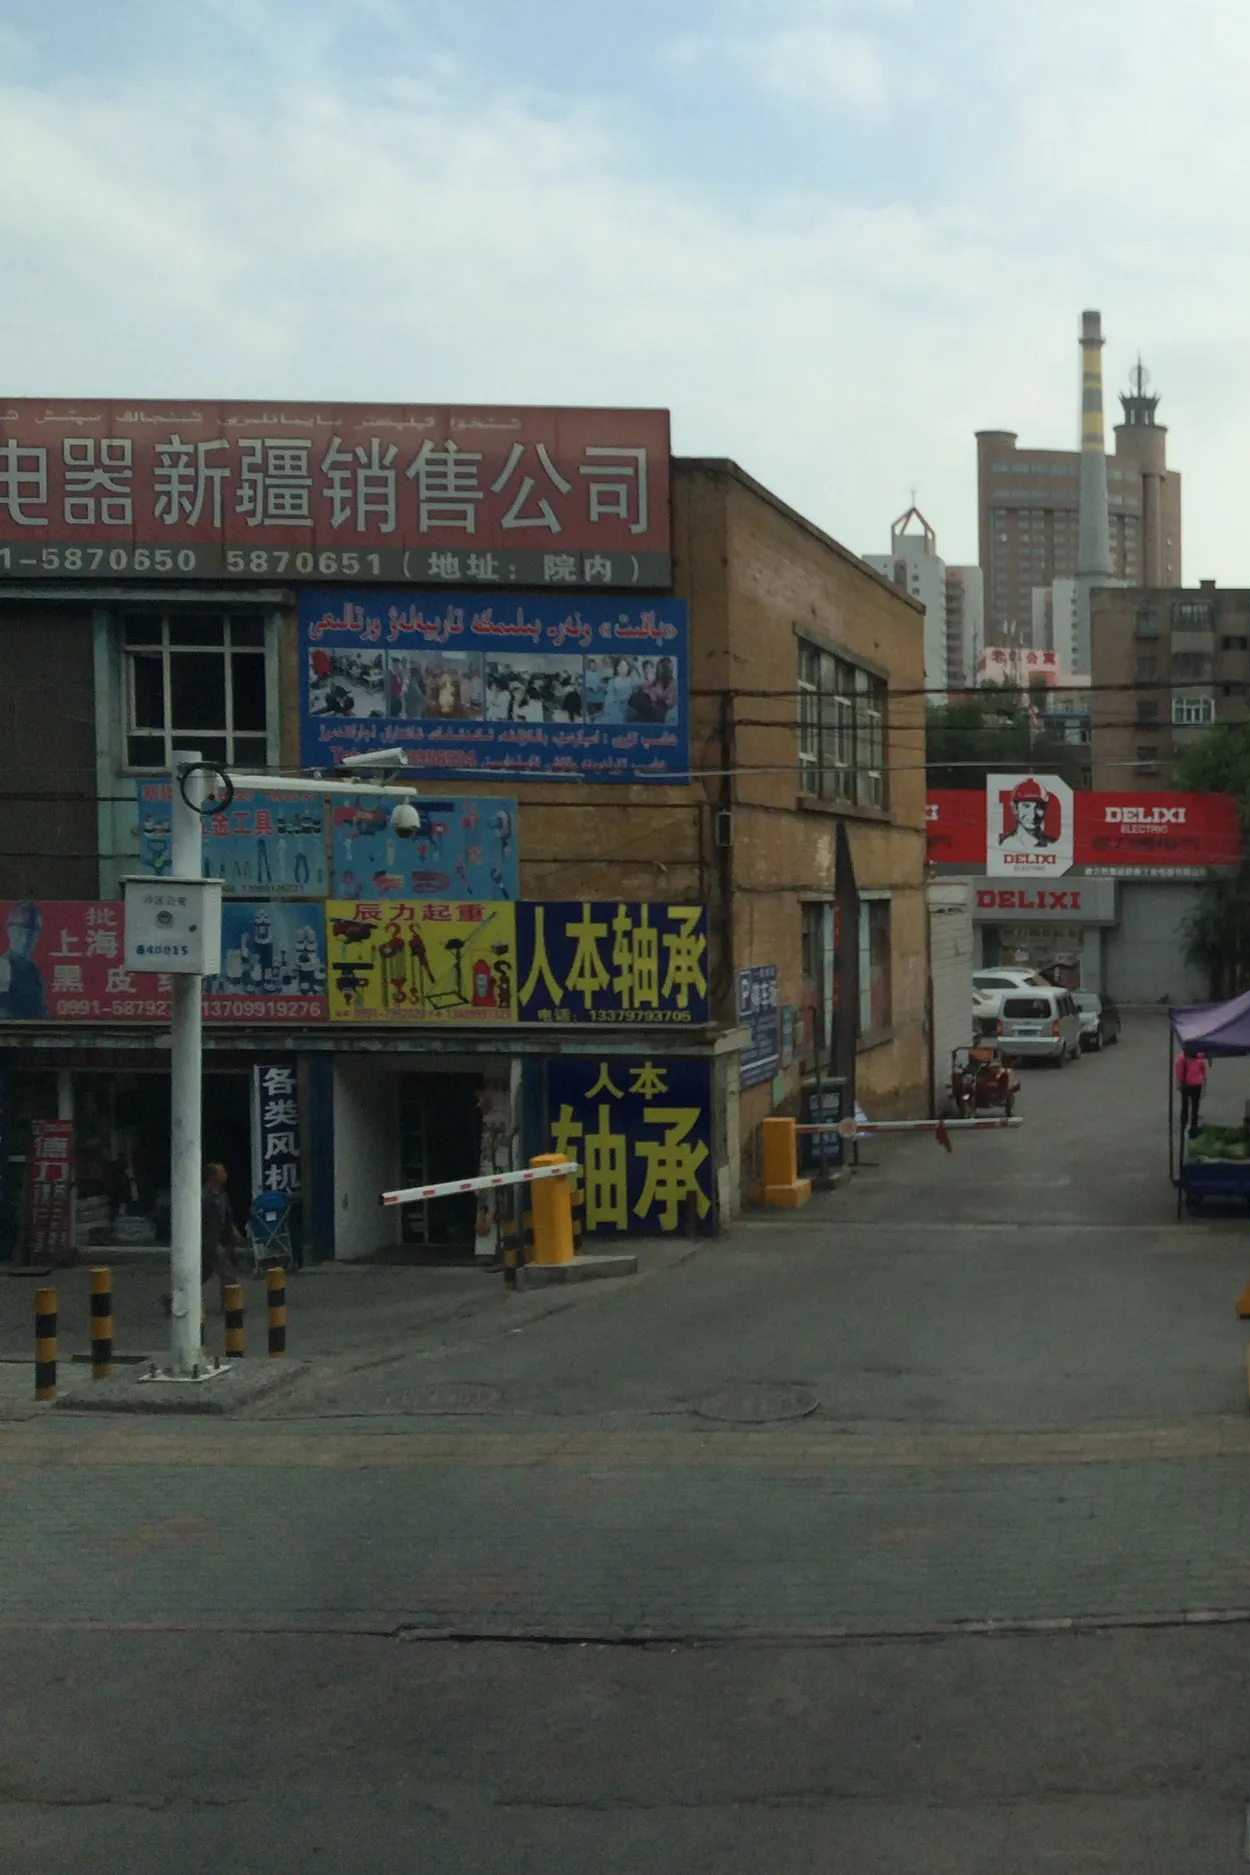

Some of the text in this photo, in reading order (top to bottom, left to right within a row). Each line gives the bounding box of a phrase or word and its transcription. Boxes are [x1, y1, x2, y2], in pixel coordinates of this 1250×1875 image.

[0, 434, 649, 535] 电器新疆销售公司
[226, 552, 381, 576] 5870651
[202, 811, 273, 836] 金工具
[1104, 807, 1187, 823] DELIXI
[1003, 853, 1056, 864] DELIXI
[976, 890, 1081, 909] DELIXI
[353, 903, 484, 922] 辰力起重
[518, 903, 708, 1010] 人本轴承
[585, 1062, 668, 1099] 人本
[262, 1067, 299, 1195] 各类风机
[551, 1104, 711, 1232] 轴承
